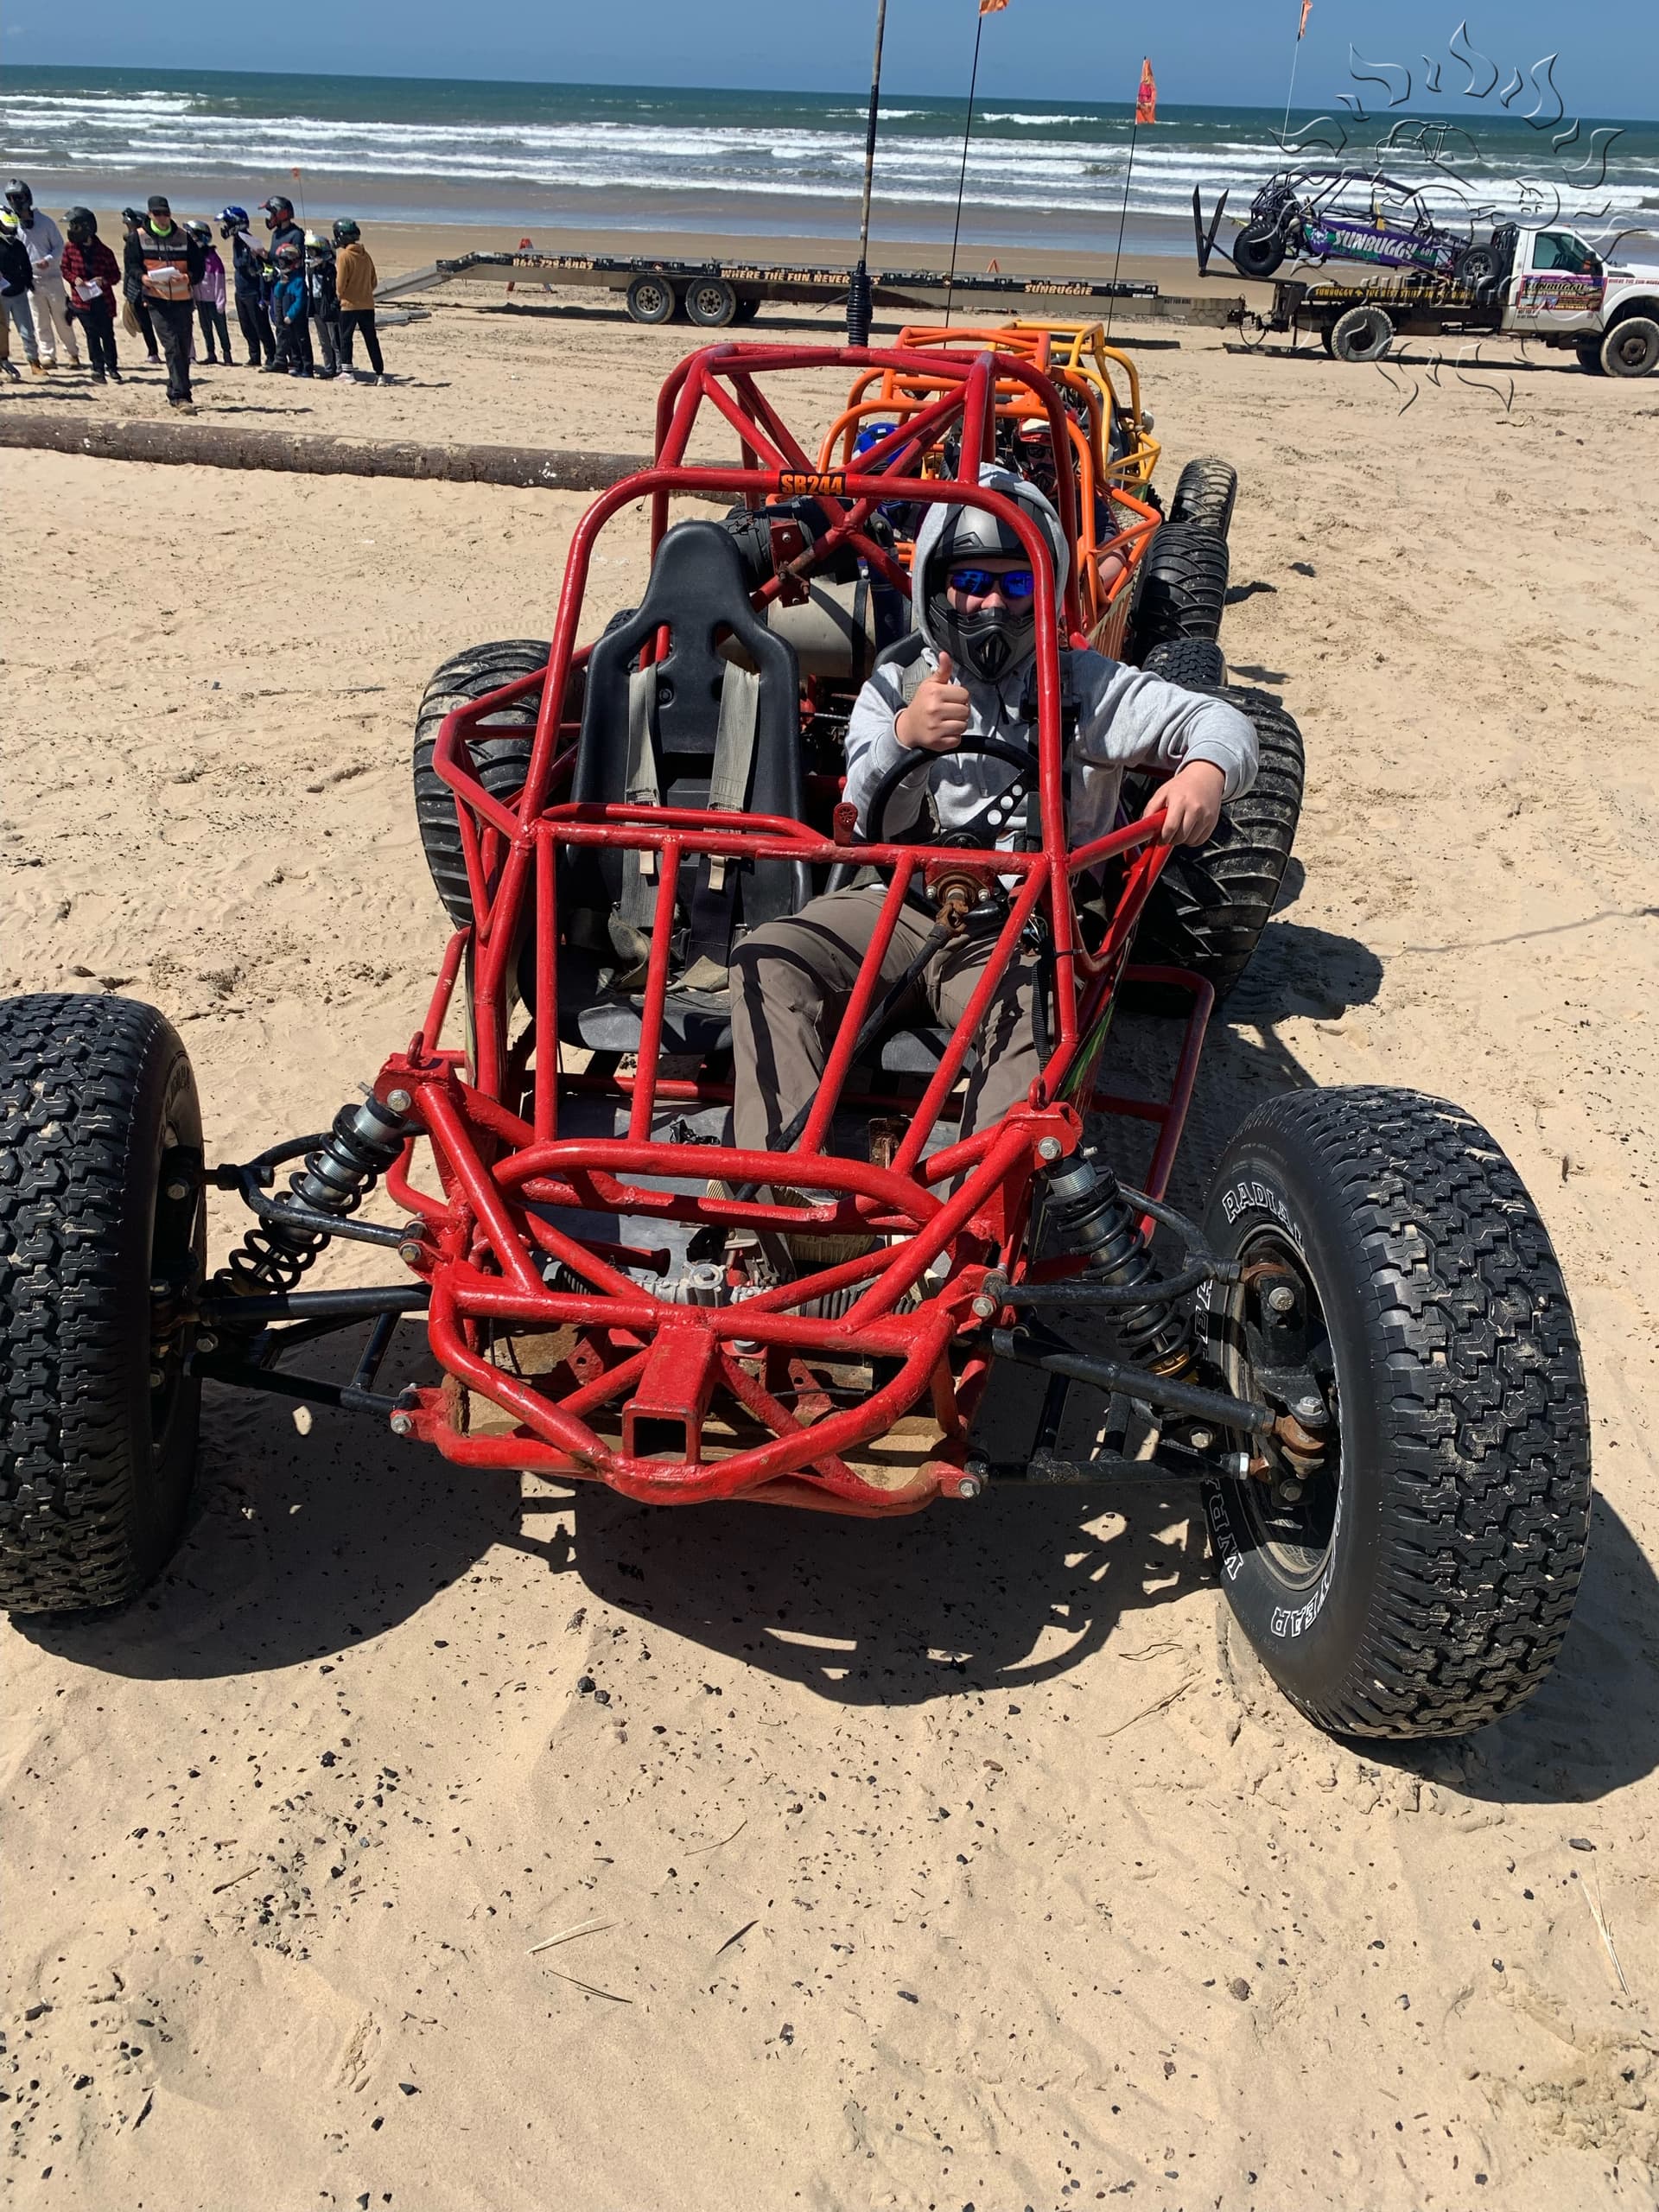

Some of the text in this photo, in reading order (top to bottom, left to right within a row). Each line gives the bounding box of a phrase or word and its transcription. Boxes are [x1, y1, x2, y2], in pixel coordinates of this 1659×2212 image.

[1333, 230, 1419, 259] SUNBUGGY
[721, 268, 851, 284] WHERE THE FUN NEVER
[1025, 283, 1093, 296] SUNBUGGIE
[780, 474, 843, 495] SB244
[1222, 1181, 1304, 1251] RADIAL
